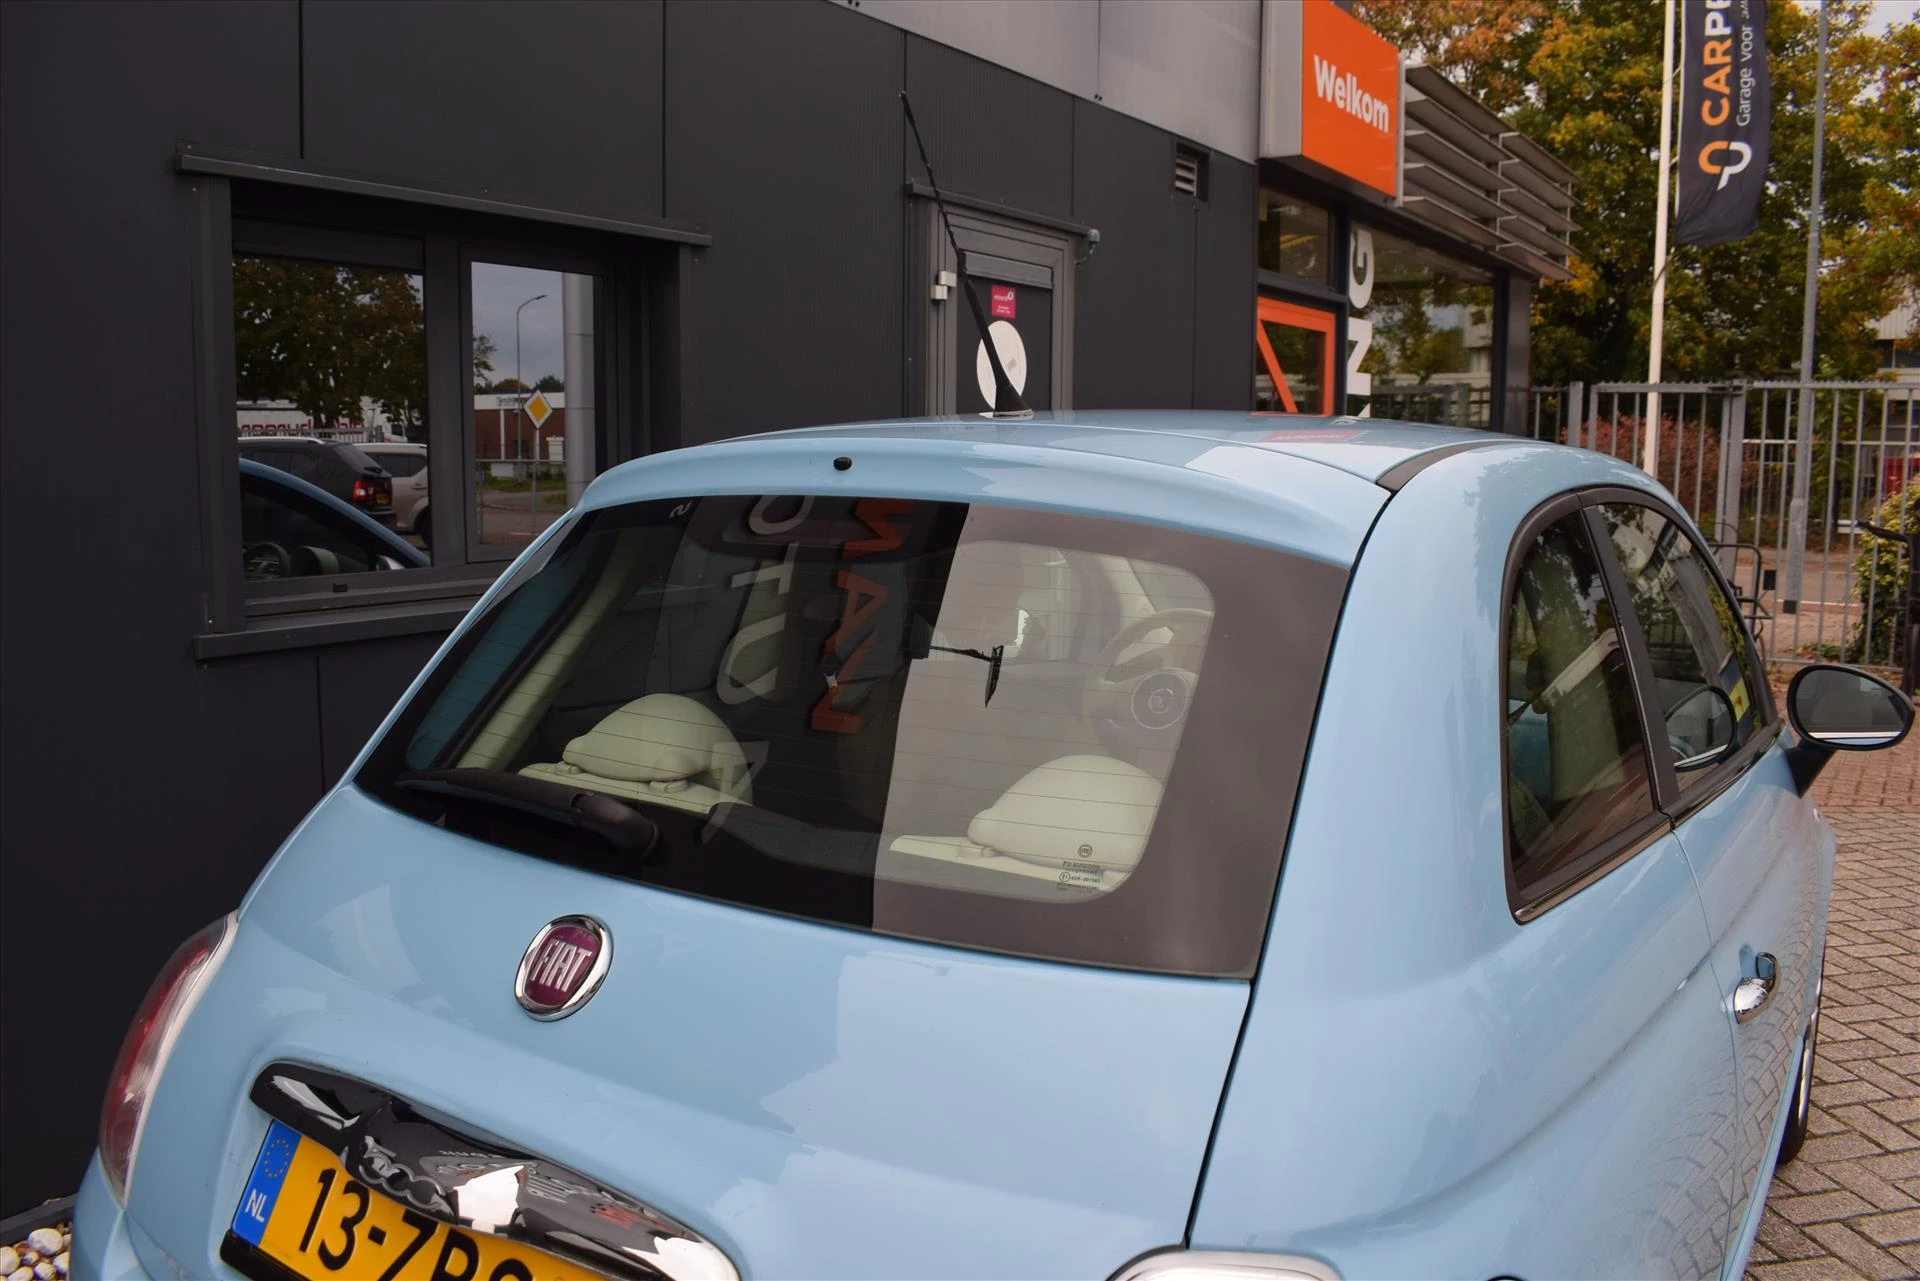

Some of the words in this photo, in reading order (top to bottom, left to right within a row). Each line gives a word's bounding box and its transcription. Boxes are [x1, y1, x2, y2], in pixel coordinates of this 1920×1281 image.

[1741, 25, 1754, 62] voor
[1313, 54, 1389, 134] Welkom
[1736, 68, 1756, 127] Garage
[530, 938, 592, 993] FIAT
[245, 1188, 268, 1223] NL
